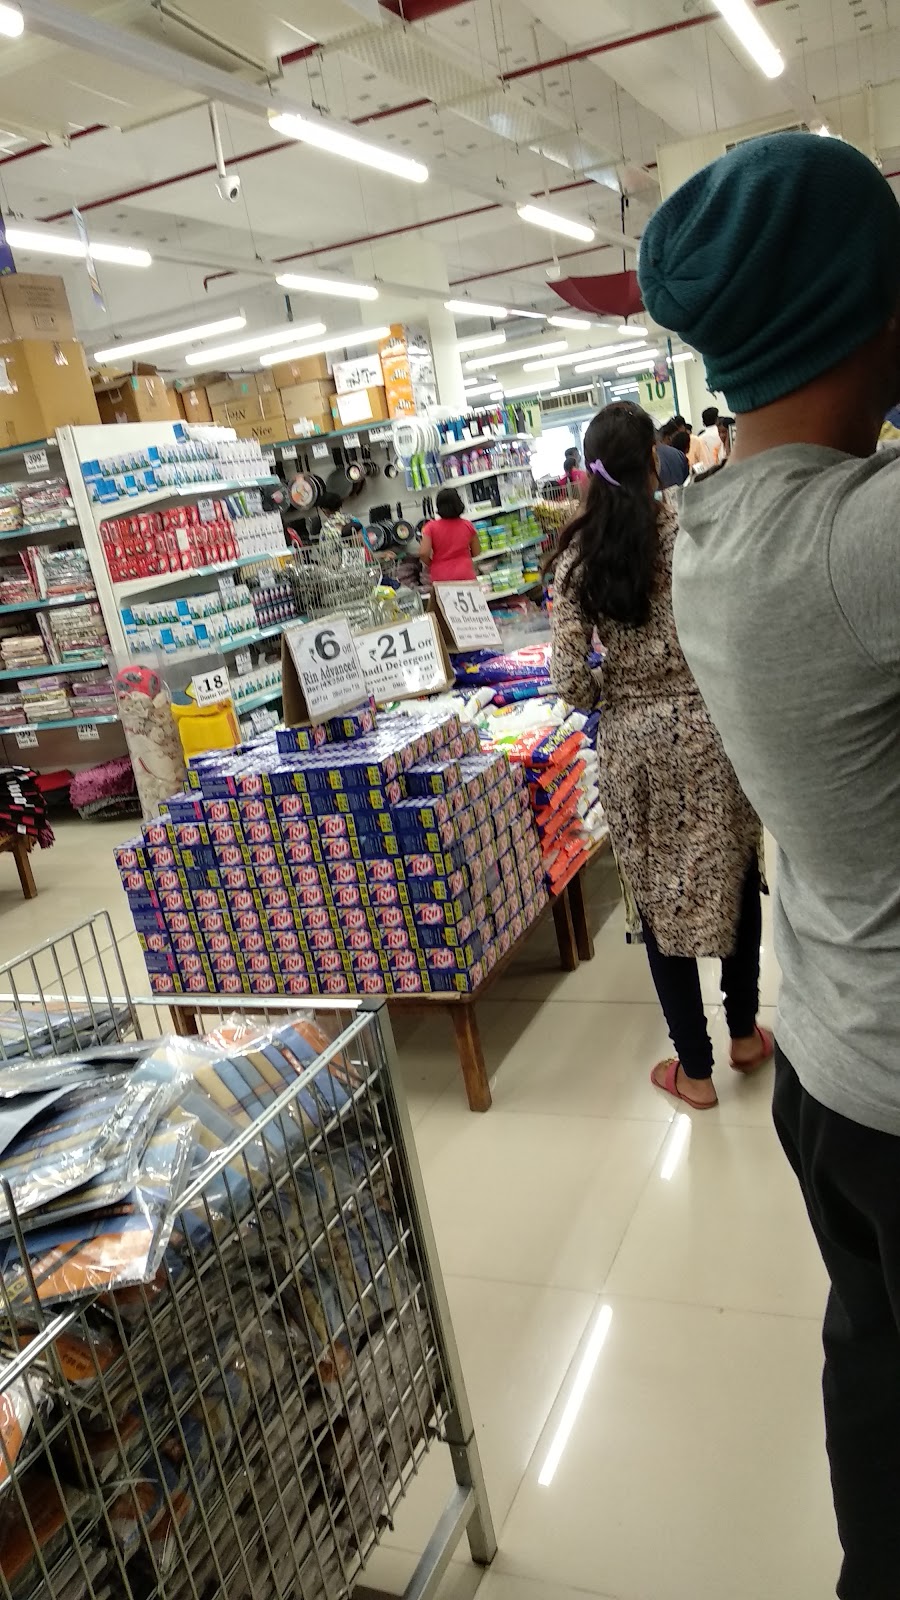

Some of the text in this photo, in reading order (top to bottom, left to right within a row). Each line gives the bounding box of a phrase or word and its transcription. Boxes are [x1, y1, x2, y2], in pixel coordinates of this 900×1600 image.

[646, 381, 666, 401] 10
[251, 426, 273, 438] Nice
[303, 657, 357, 686] Rin Advanced
[362, 665, 384, 678] hadi
[385, 650, 435, 671] Detergent
[243, 778, 262, 794] Rin
[212, 804, 228, 820] Rin
[245, 802, 262, 819] Rin
[283, 800, 300, 815] Rin
[150, 828, 166, 843] Rin
[216, 826, 232, 842] Rin
[252, 824, 270, 841] Rin
[289, 826, 308, 840] Rin
[326, 820, 344, 836] Rin
[182, 828, 198, 845] Rin
[156, 850, 173, 865] Rin
[224, 849, 240, 865] Rin
[257, 848, 274, 864] Rin
[292, 846, 310, 861] Rin
[330, 843, 348, 858] Rin
[121, 852, 136, 867] Rin
[336, 867, 355, 882] Rin
[374, 865, 394, 881] Rin
[413, 860, 433, 876] Rin
[128, 874, 143, 889] Rin
[161, 873, 177, 888] Rin
[228, 872, 244, 888] Rin
[263, 870, 280, 886] Rin
[301, 870, 318, 884] Rin
[166, 894, 182, 909] Rin
[198, 893, 216, 908] Rin
[234, 893, 251, 908] Rin
[270, 891, 287, 906] Rin
[304, 890, 322, 905] Rin
[340, 889, 358, 905] Rin
[377, 888, 396, 903] Rin
[172, 916, 187, 930] Rin
[205, 915, 221, 930] Rin
[240, 914, 258, 930] Rin
[274, 914, 292, 928] Rin
[310, 913, 328, 927] Rin
[346, 913, 364, 928] Rin
[383, 912, 402, 927] Rin
[422, 909, 443, 924] Rin
[178, 937, 194, 951] Rin
[212, 936, 228, 951] Rin
[246, 934, 263, 950] Rin
[279, 936, 297, 949] Rin
[315, 934, 334, 948] Rin
[351, 934, 370, 948] Rin
[387, 934, 408, 948] Rin
[184, 957, 199, 971] Rin
[218, 956, 234, 970] Rin
[252, 956, 269, 970] Rin
[286, 957, 304, 971] Rin
[322, 956, 340, 970] Rin
[358, 955, 377, 970] Rin
[396, 954, 415, 968] Rin
[433, 954, 454, 968] Rin
[156, 977, 172, 991] Rin
[190, 976, 205, 991] Rin
[224, 977, 240, 992] Rin
[257, 977, 274, 991] Rin
[291, 978, 309, 992] Rin
[328, 978, 346, 992] Rin
[364, 978, 383, 992] Rin
[401, 975, 420, 990] Rin
